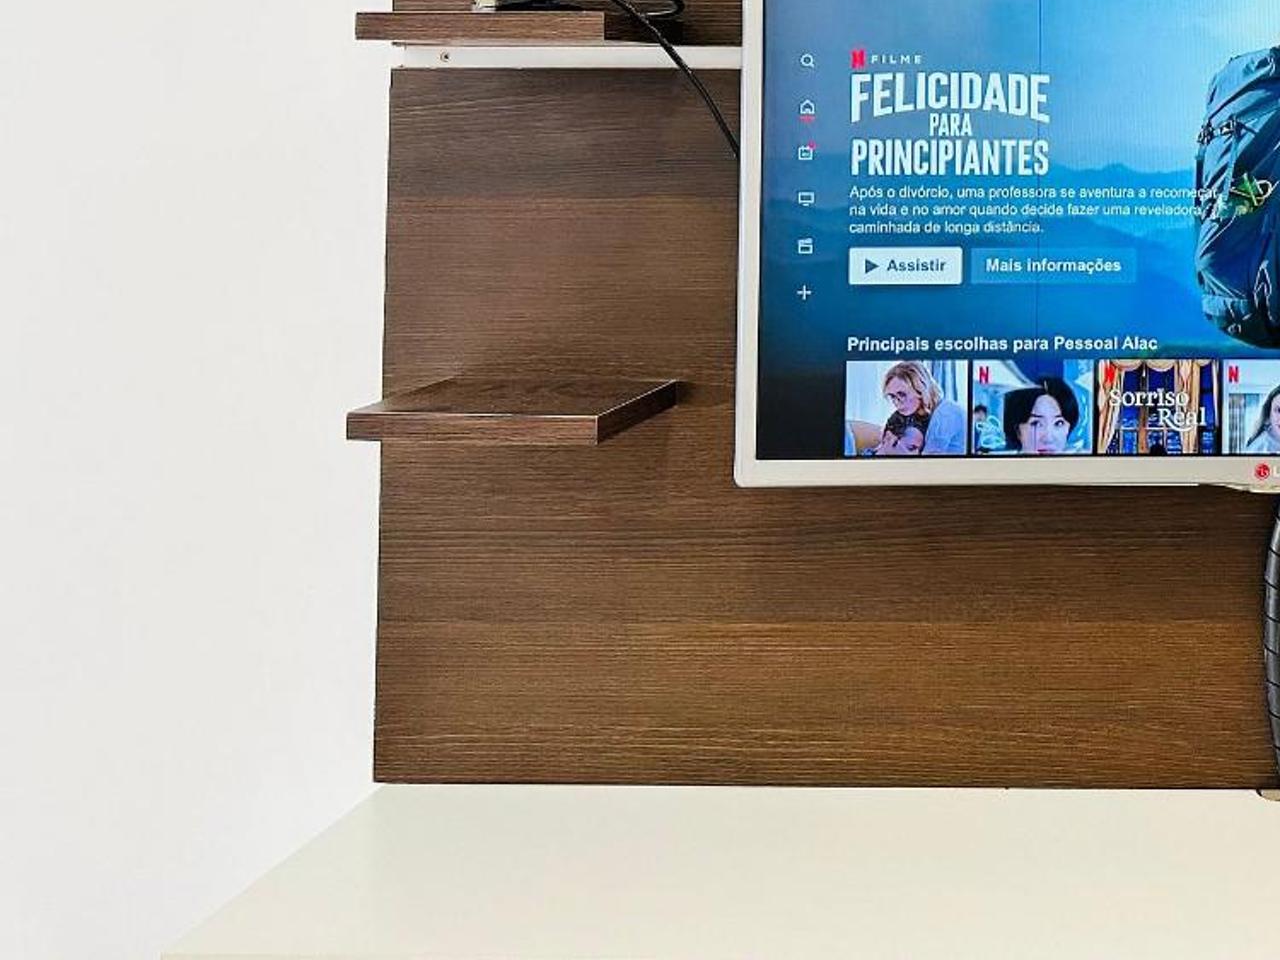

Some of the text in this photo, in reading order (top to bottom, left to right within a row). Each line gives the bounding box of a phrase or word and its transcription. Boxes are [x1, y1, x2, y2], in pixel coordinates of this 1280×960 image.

[871, 55, 923, 64] FILME
[850, 72, 1051, 123] FELICIDADE
[929, 113, 973, 136] PARA
[851, 139, 1050, 176] PRINCIPIANTES
[850, 186, 883, 200] Após
[887, 188, 895, 198] o
[899, 186, 953, 199] divórcio,
[957, 188, 984, 198] uma
[989, 186, 1056, 201] professora
[1060, 188, 1075, 198] se
[1080, 187, 1134, 198] aventura
[1138, 188, 1146, 198] a
[849, 203, 1203, 217] na vida e no amor quando decide fazer uma reveladora
[849, 221, 1044, 235] caminhada de longa distância.
[887, 258, 948, 272] Assistir
[986, 258, 1122, 274] Mais informações
[847, 337, 1158, 354] Principais escolhas para Pessoal Alac
[979, 366, 989, 384] N
[1228, 366, 1239, 383] N
[1109, 388, 1189, 406] Sorriso
[1158, 407, 1207, 432] Real
